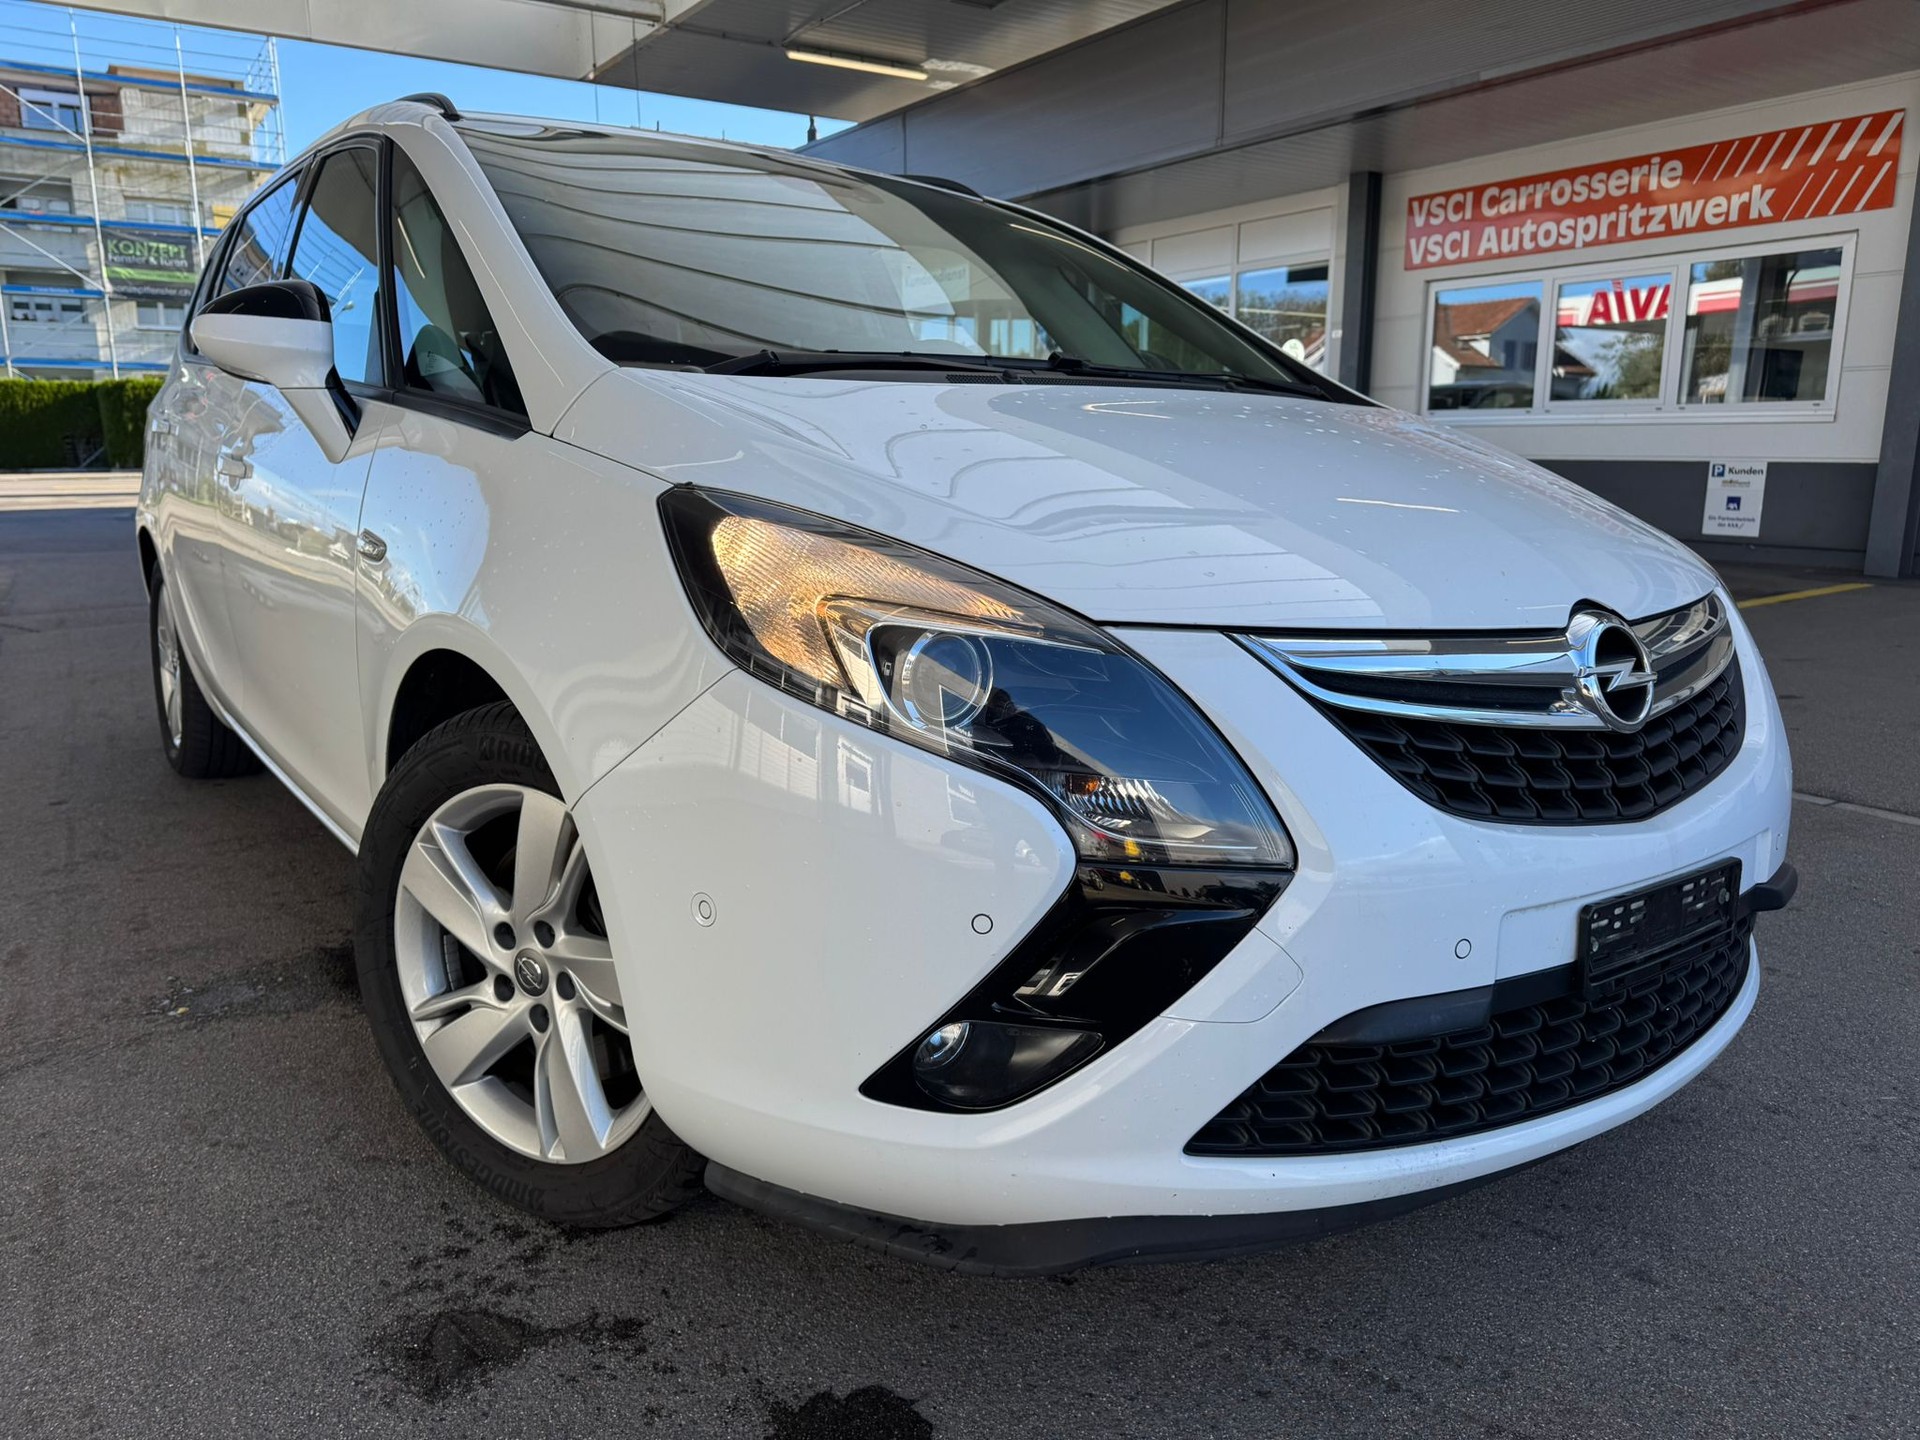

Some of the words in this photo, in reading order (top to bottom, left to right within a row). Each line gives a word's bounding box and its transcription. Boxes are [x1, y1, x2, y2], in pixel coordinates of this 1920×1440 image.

[1412, 191, 1474, 228] VSCI
[1481, 156, 1683, 218] Carrosserie
[1410, 230, 1470, 265] VSCI
[1477, 184, 1776, 256] Autospritzwerk
[107, 239, 187, 259] KONZEPT
[1728, 466, 1764, 475] Kunden
